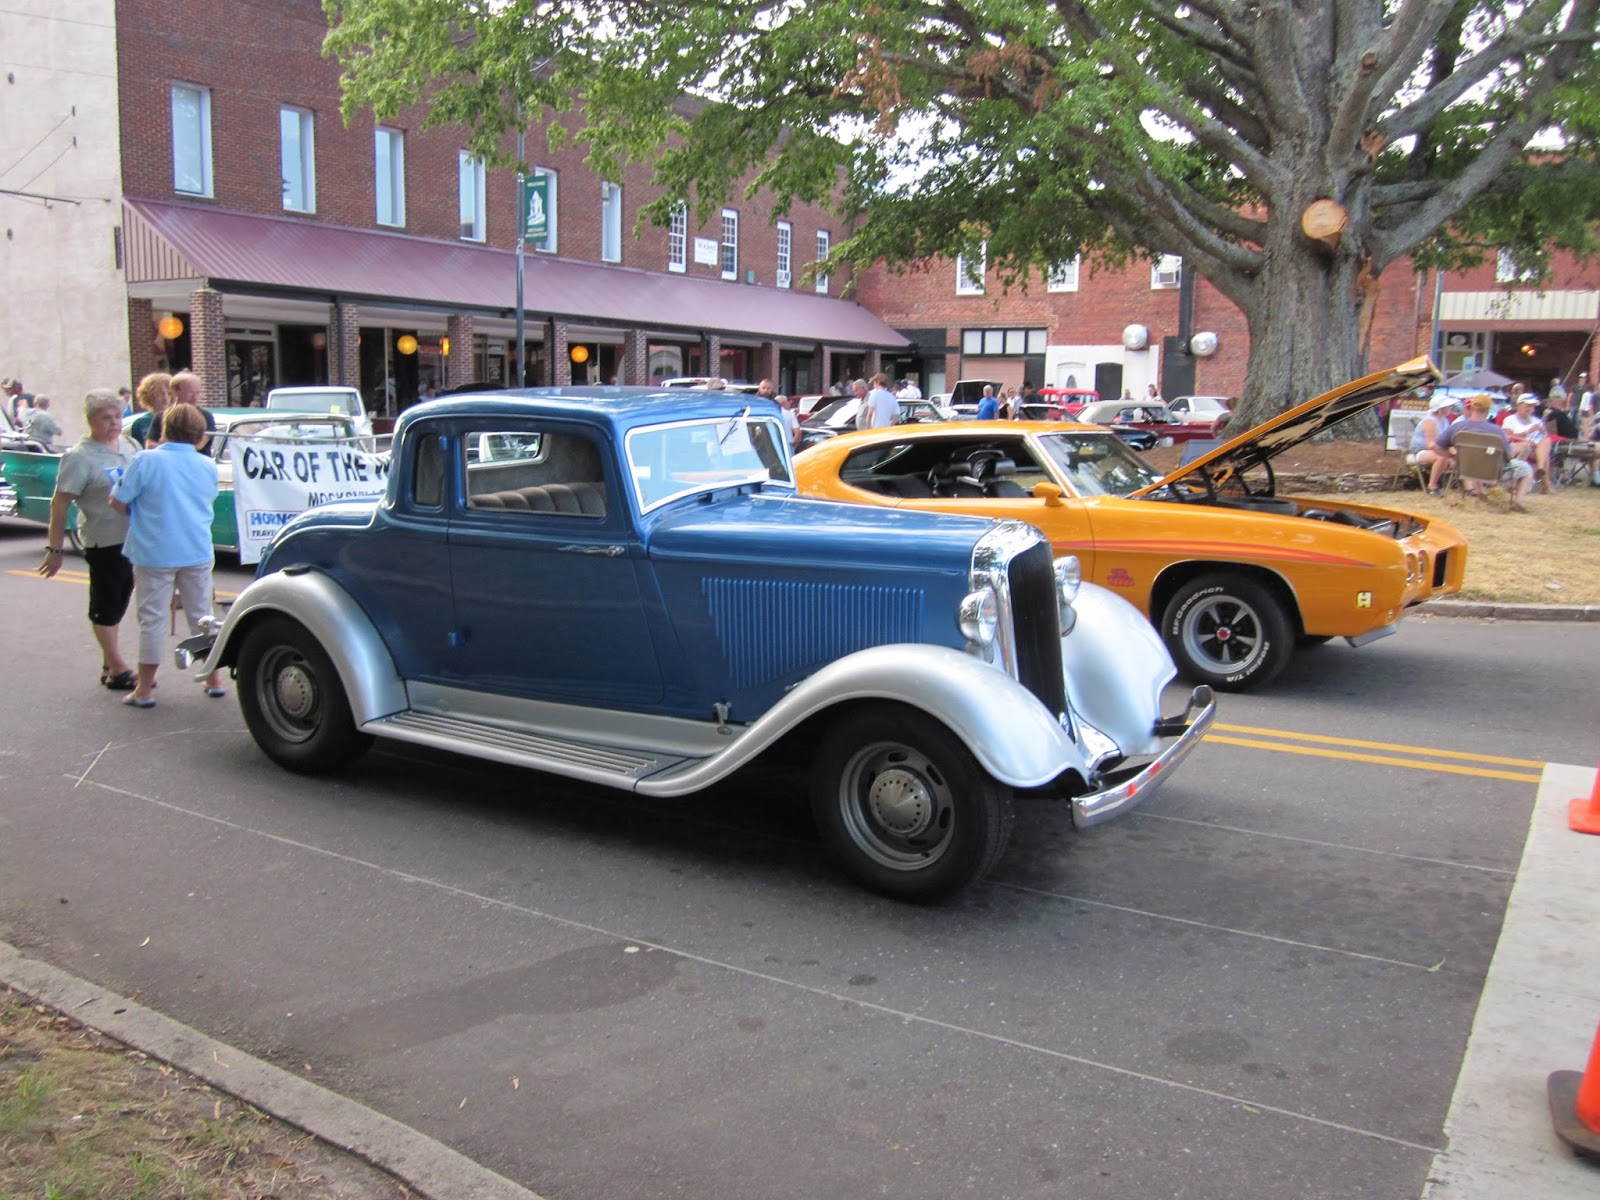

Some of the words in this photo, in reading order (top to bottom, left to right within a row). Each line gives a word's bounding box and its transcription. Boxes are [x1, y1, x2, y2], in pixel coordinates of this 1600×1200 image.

[243, 447, 291, 480] CAR
[294, 451, 320, 482] OF
[327, 451, 368, 481] THE
[1173, 587, 1224, 635] BFGoodrich
